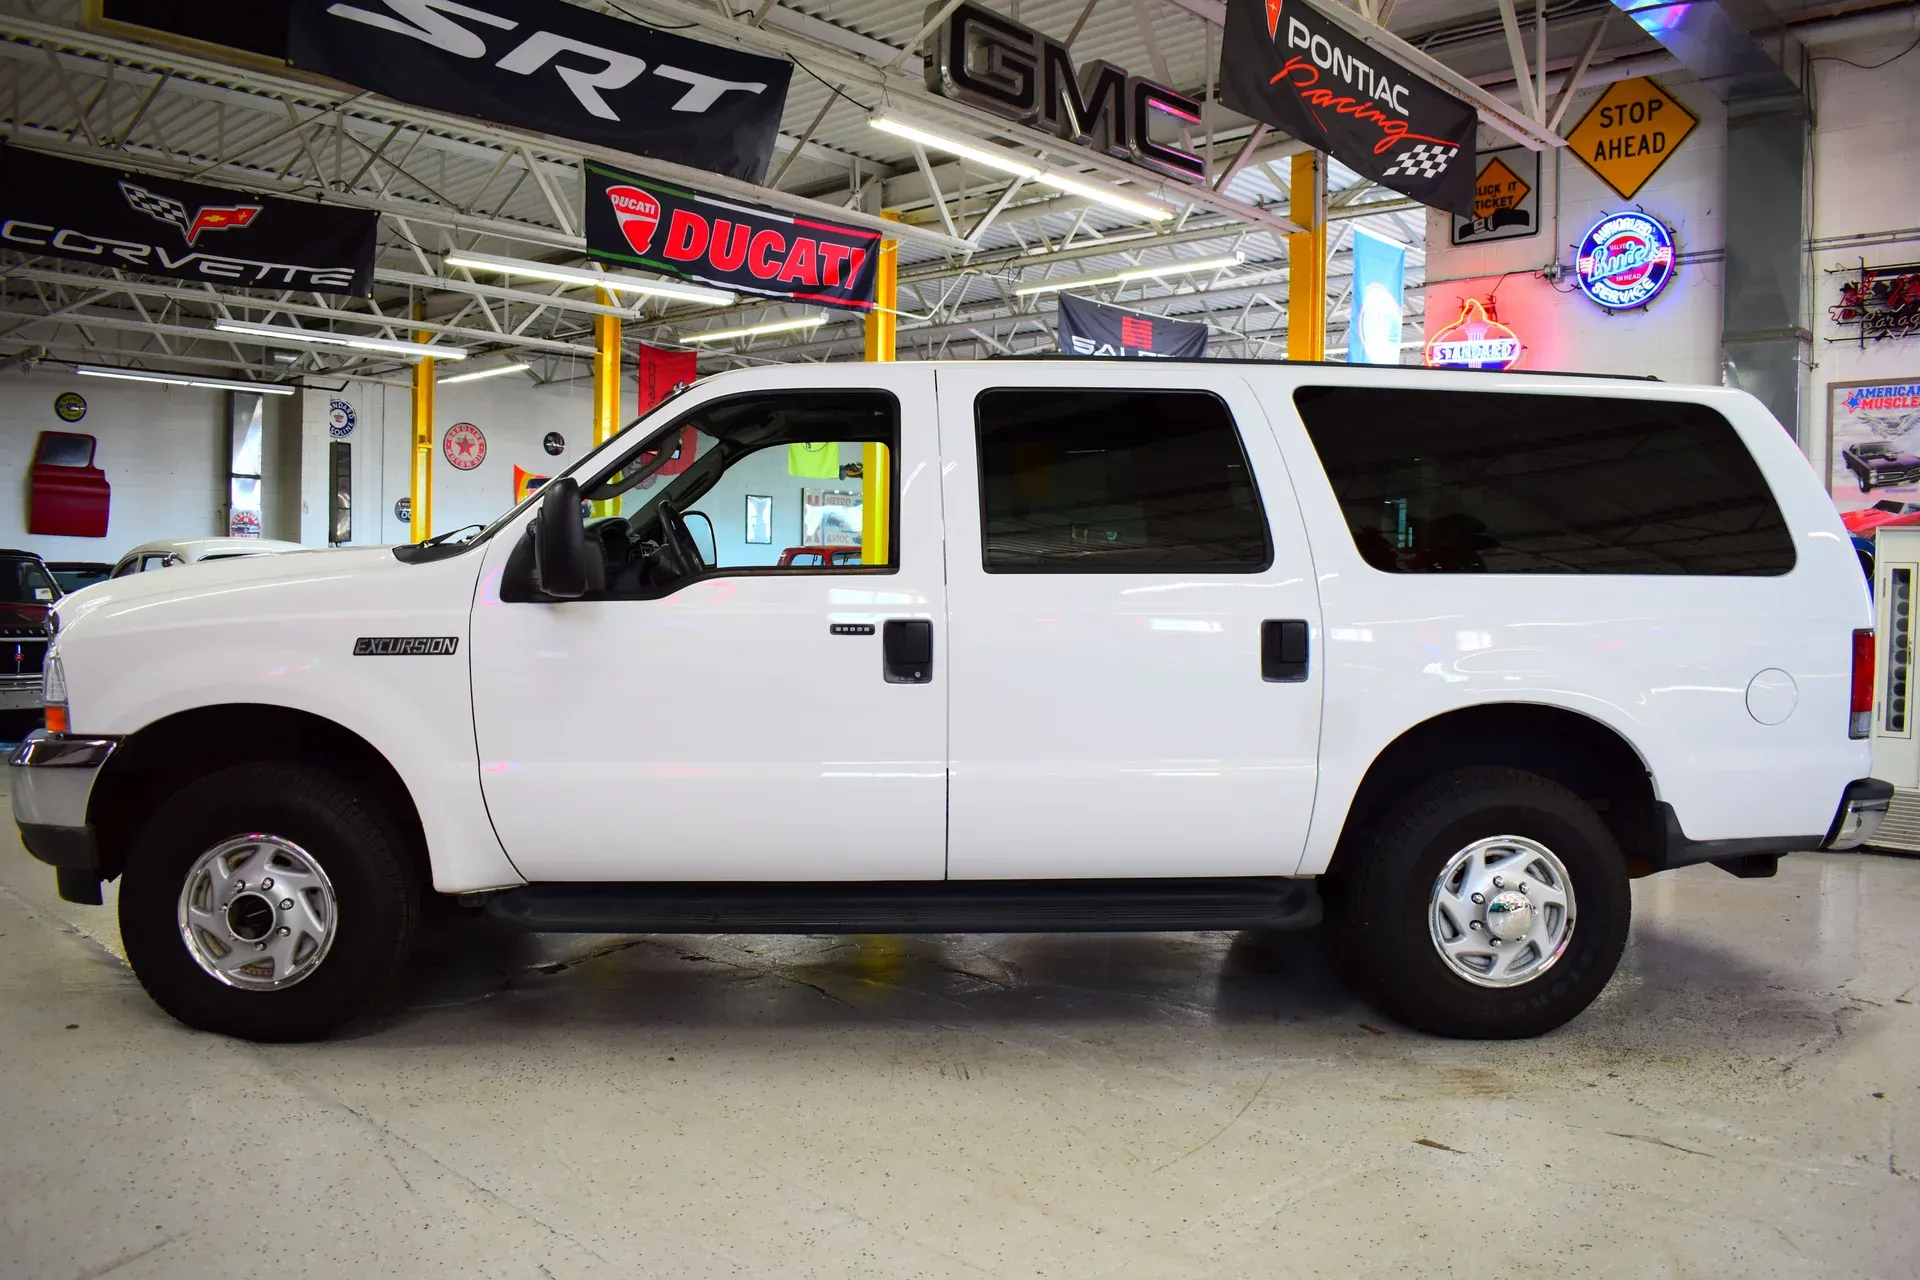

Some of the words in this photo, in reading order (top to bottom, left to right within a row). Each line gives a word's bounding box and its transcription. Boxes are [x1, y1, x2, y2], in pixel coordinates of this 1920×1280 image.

[326, 0, 768, 121] SRT
[1288, 16, 1409, 116] PONTIAC
[924, 0, 1206, 184] GMC
[1270, 56, 1460, 154] Racing
[1600, 99, 1663, 128] STOP
[1594, 131, 1665, 162] AHEAD
[1508, 181, 1517, 192] IT
[611, 193, 656, 215] DUCATI
[1475, 195, 1514, 210] TICKET
[1593, 217, 1653, 245] AUTHORIZED
[1, 220, 355, 287] CORVETTE
[663, 208, 866, 290] DUCATI
[1591, 277, 1655, 303] SERVICE
[1624, 273, 1641, 281] HEAD
[1434, 343, 1516, 361] STANDARD
[1861, 396, 1920, 410] MUSCLE
[447, 425, 484, 442] GASOLINE
[355, 639, 457, 654] EXCURSION
